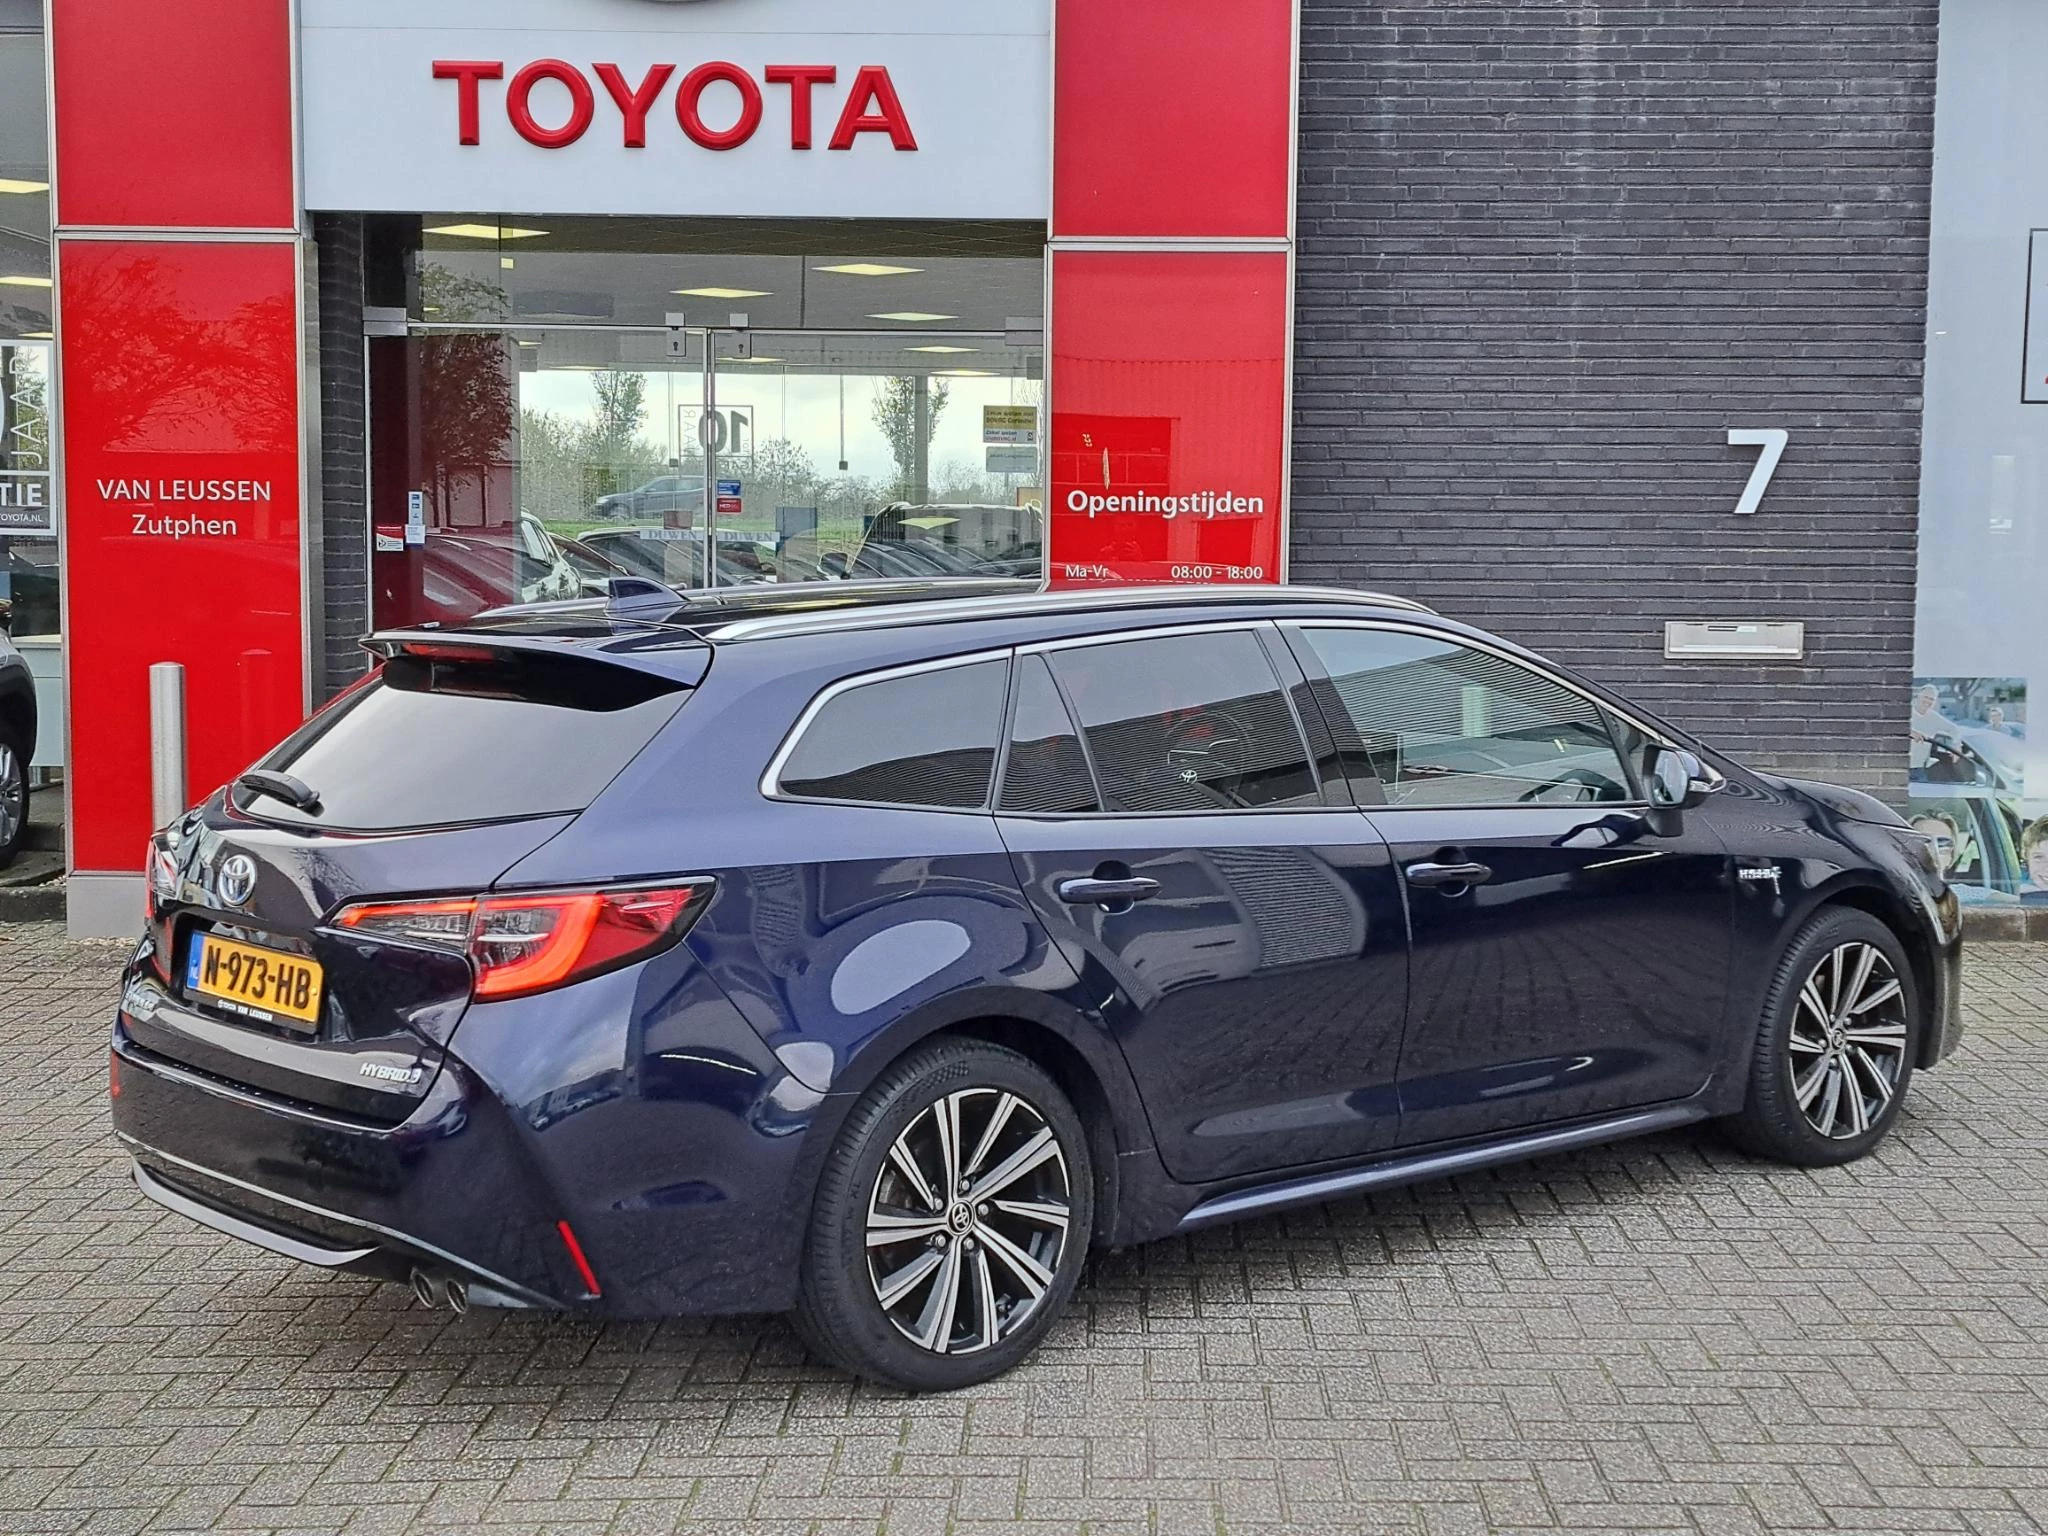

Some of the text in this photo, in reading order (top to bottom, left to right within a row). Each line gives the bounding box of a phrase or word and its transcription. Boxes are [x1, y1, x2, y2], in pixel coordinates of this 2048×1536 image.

[432, 58, 918, 151] TOYOTA
[9, 355, 42, 465] JAAR
[1728, 429, 1788, 513] 7
[97, 479, 270, 501] VAN LEUSSEN
[0, 513, 44, 523] OYOTA.NL
[1067, 490, 1264, 519] Openingstijden
[132, 514, 237, 540] Zutphen
[1065, 564, 1108, 578] Ma-Vr
[1171, 565, 1212, 579] 08:00
[1227, 565, 1263, 579] 18:00
[204, 945, 311, 1010] N-973-HB
[360, 1062, 411, 1082] HYBRID
